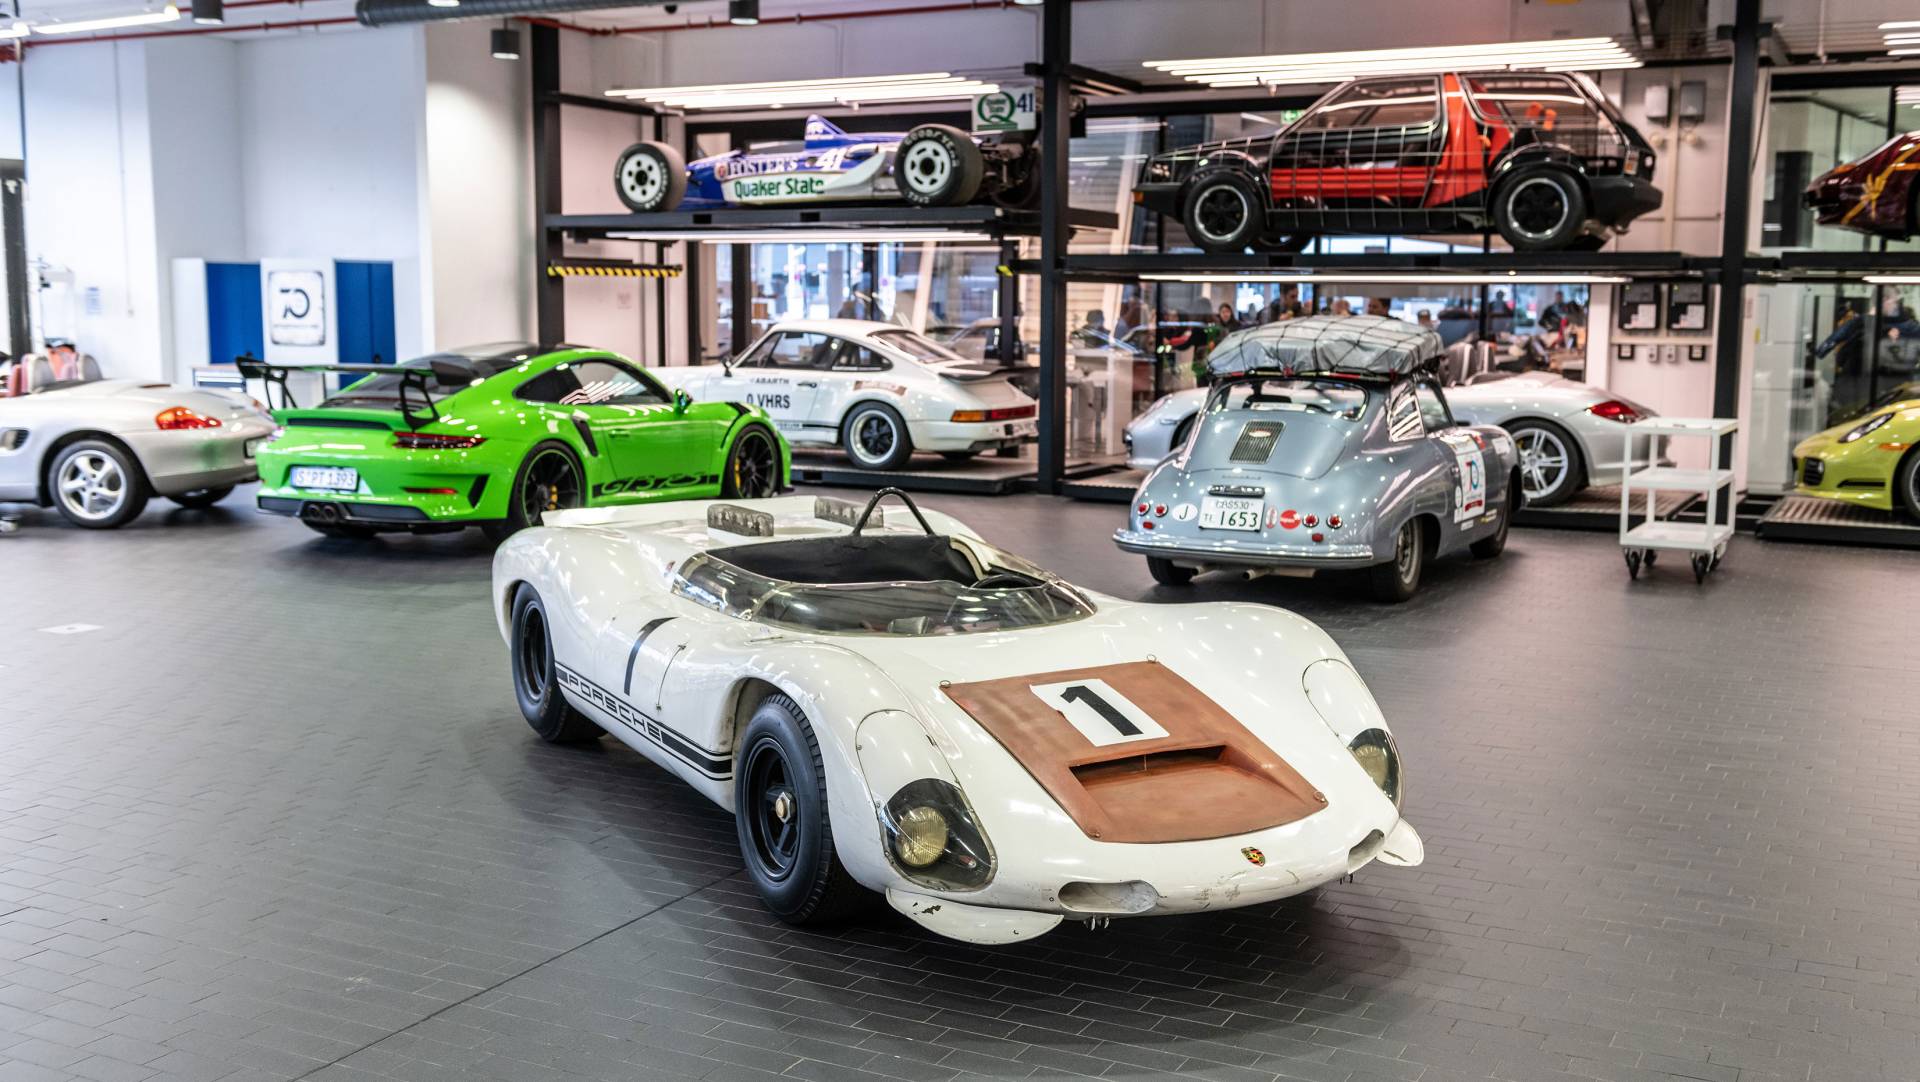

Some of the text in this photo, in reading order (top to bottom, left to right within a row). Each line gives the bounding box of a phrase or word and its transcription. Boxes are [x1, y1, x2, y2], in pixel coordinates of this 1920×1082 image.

[1016, 93, 1033, 113] 41
[815, 145, 849, 172] 41
[734, 179, 782, 199] Quaker
[757, 393, 791, 409] VHRS
[1179, 505, 1189, 520] J
[1219, 510, 1258, 529] 1653
[568, 674, 662, 742] PORSCHE
[1060, 685, 1144, 736] 1
